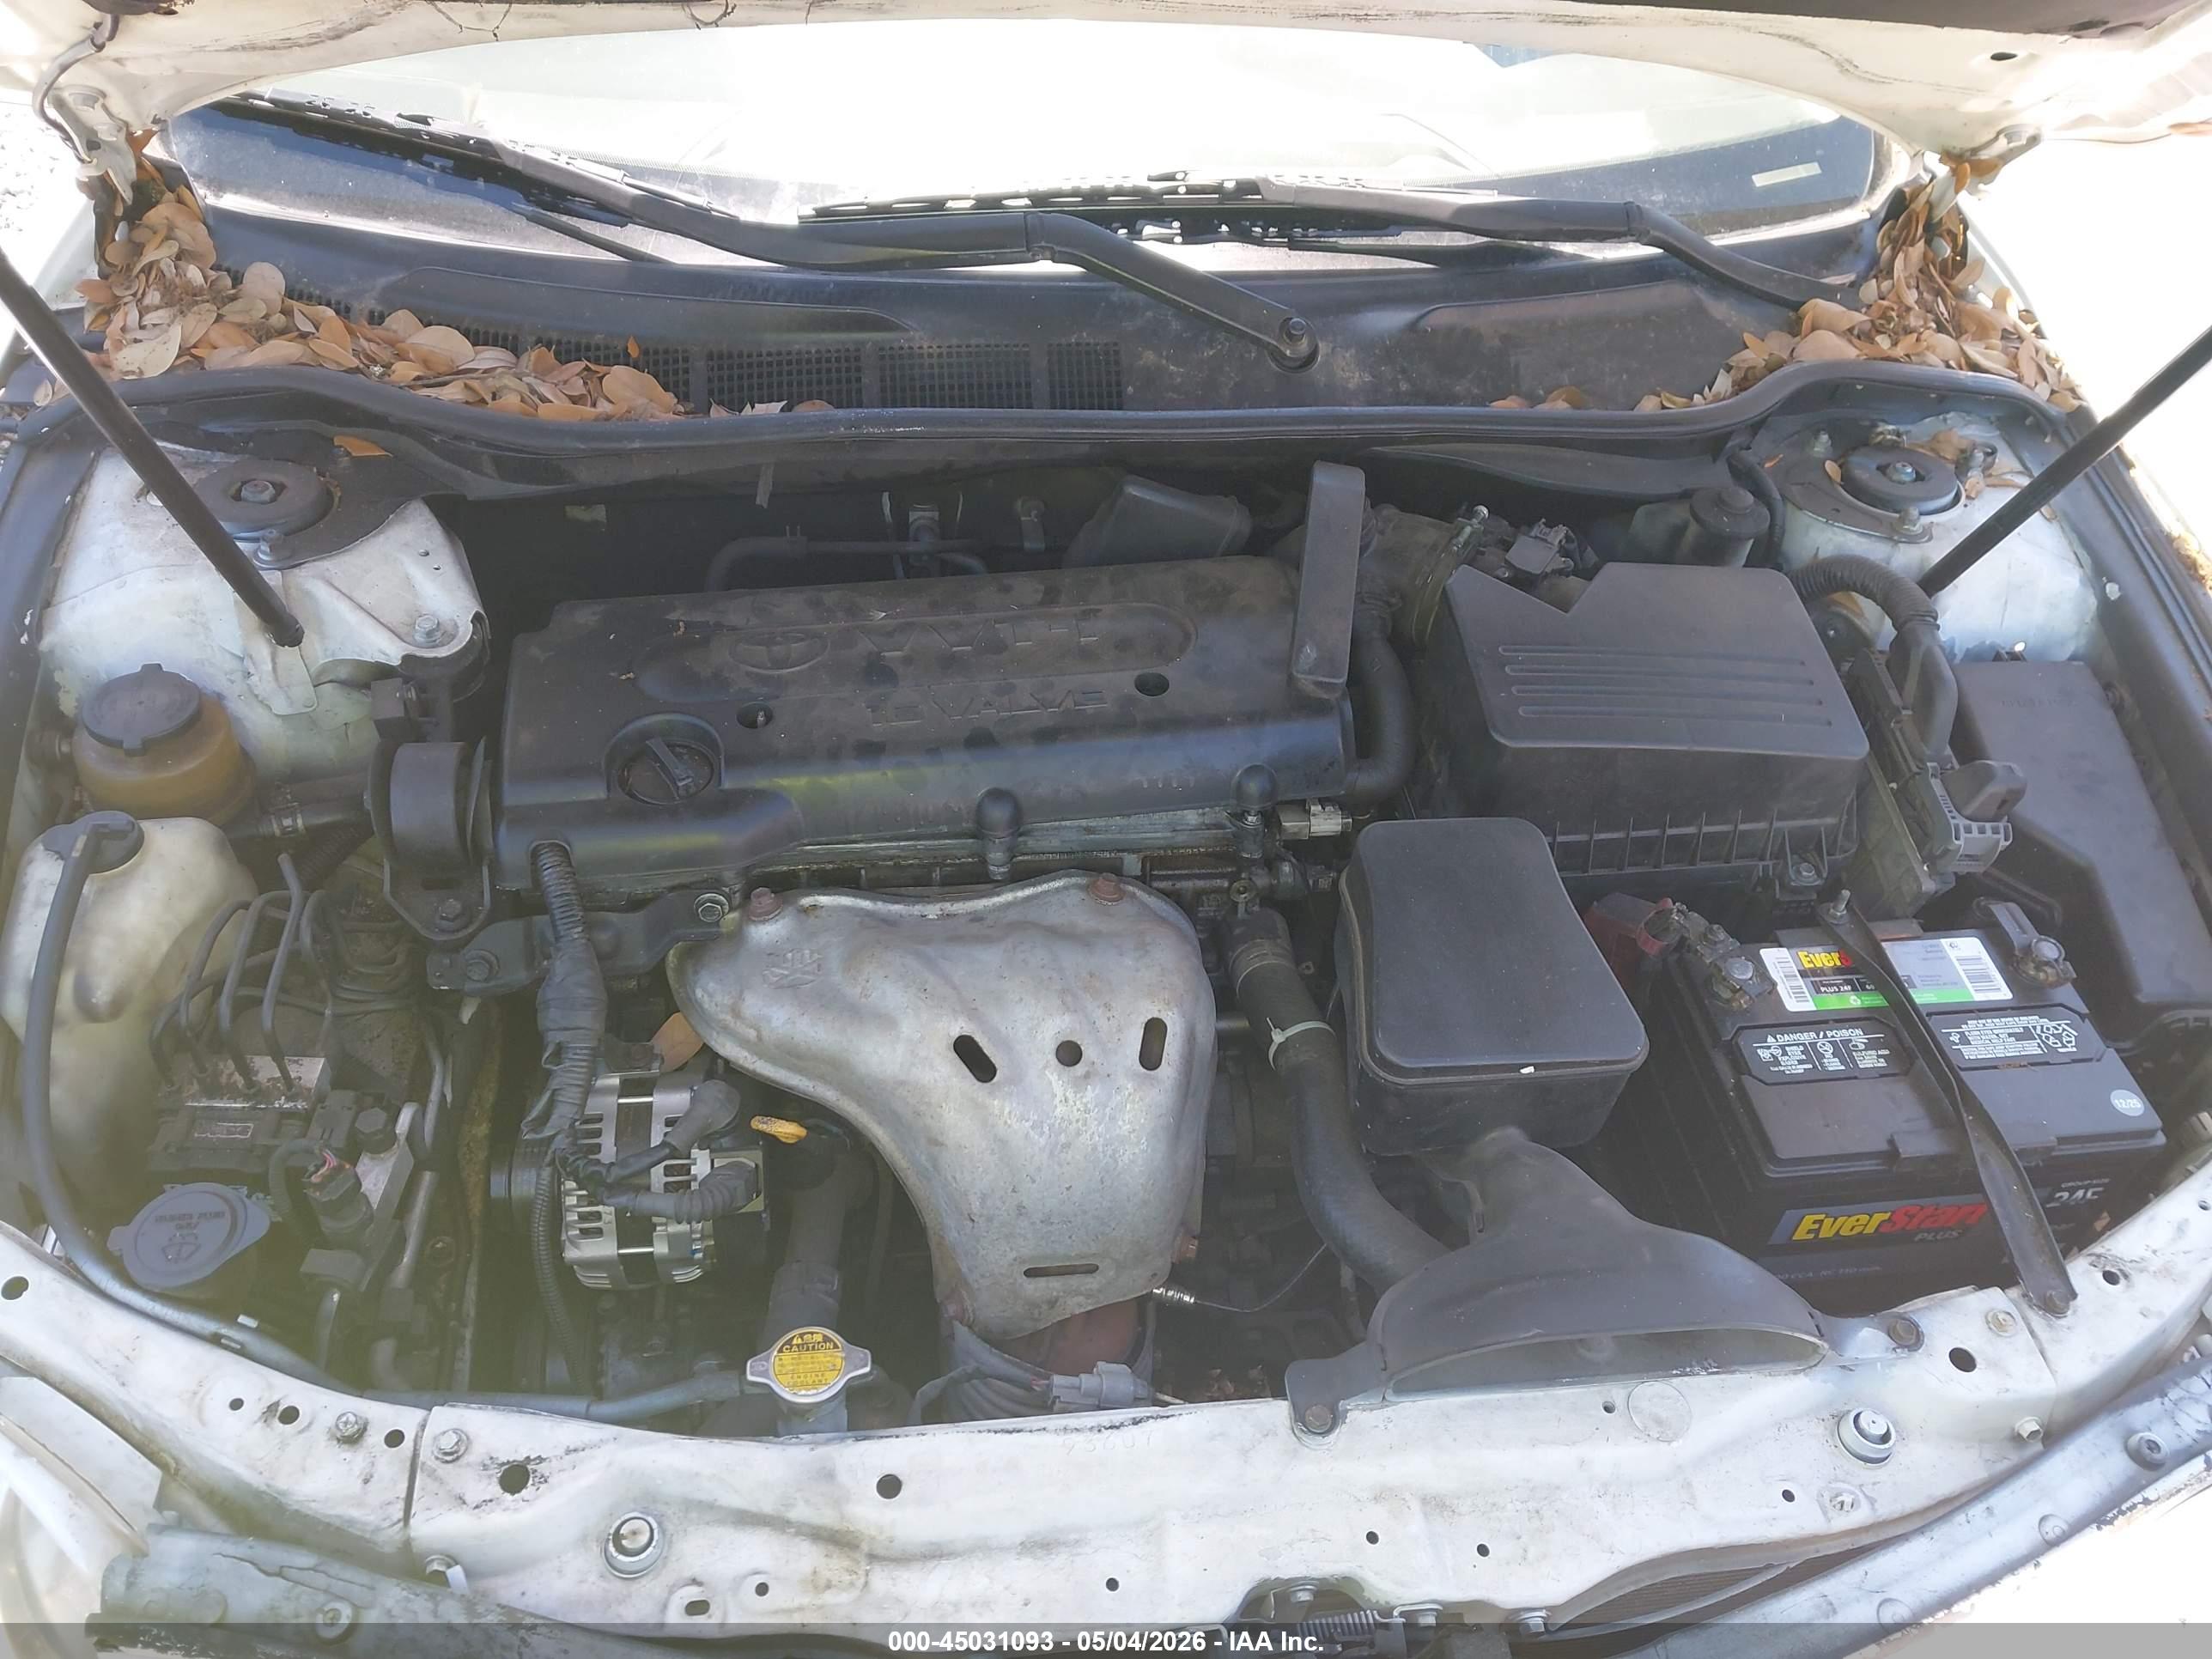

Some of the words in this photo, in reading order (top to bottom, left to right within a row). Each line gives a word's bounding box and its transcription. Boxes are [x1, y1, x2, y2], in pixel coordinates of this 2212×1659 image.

[1777, 1032, 1818, 1042] DANGER
[1826, 1028, 1863, 1037] POISON
[1914, 1230, 1961, 1241] PLUS
[782, 1341, 834, 1353] CAUTION
